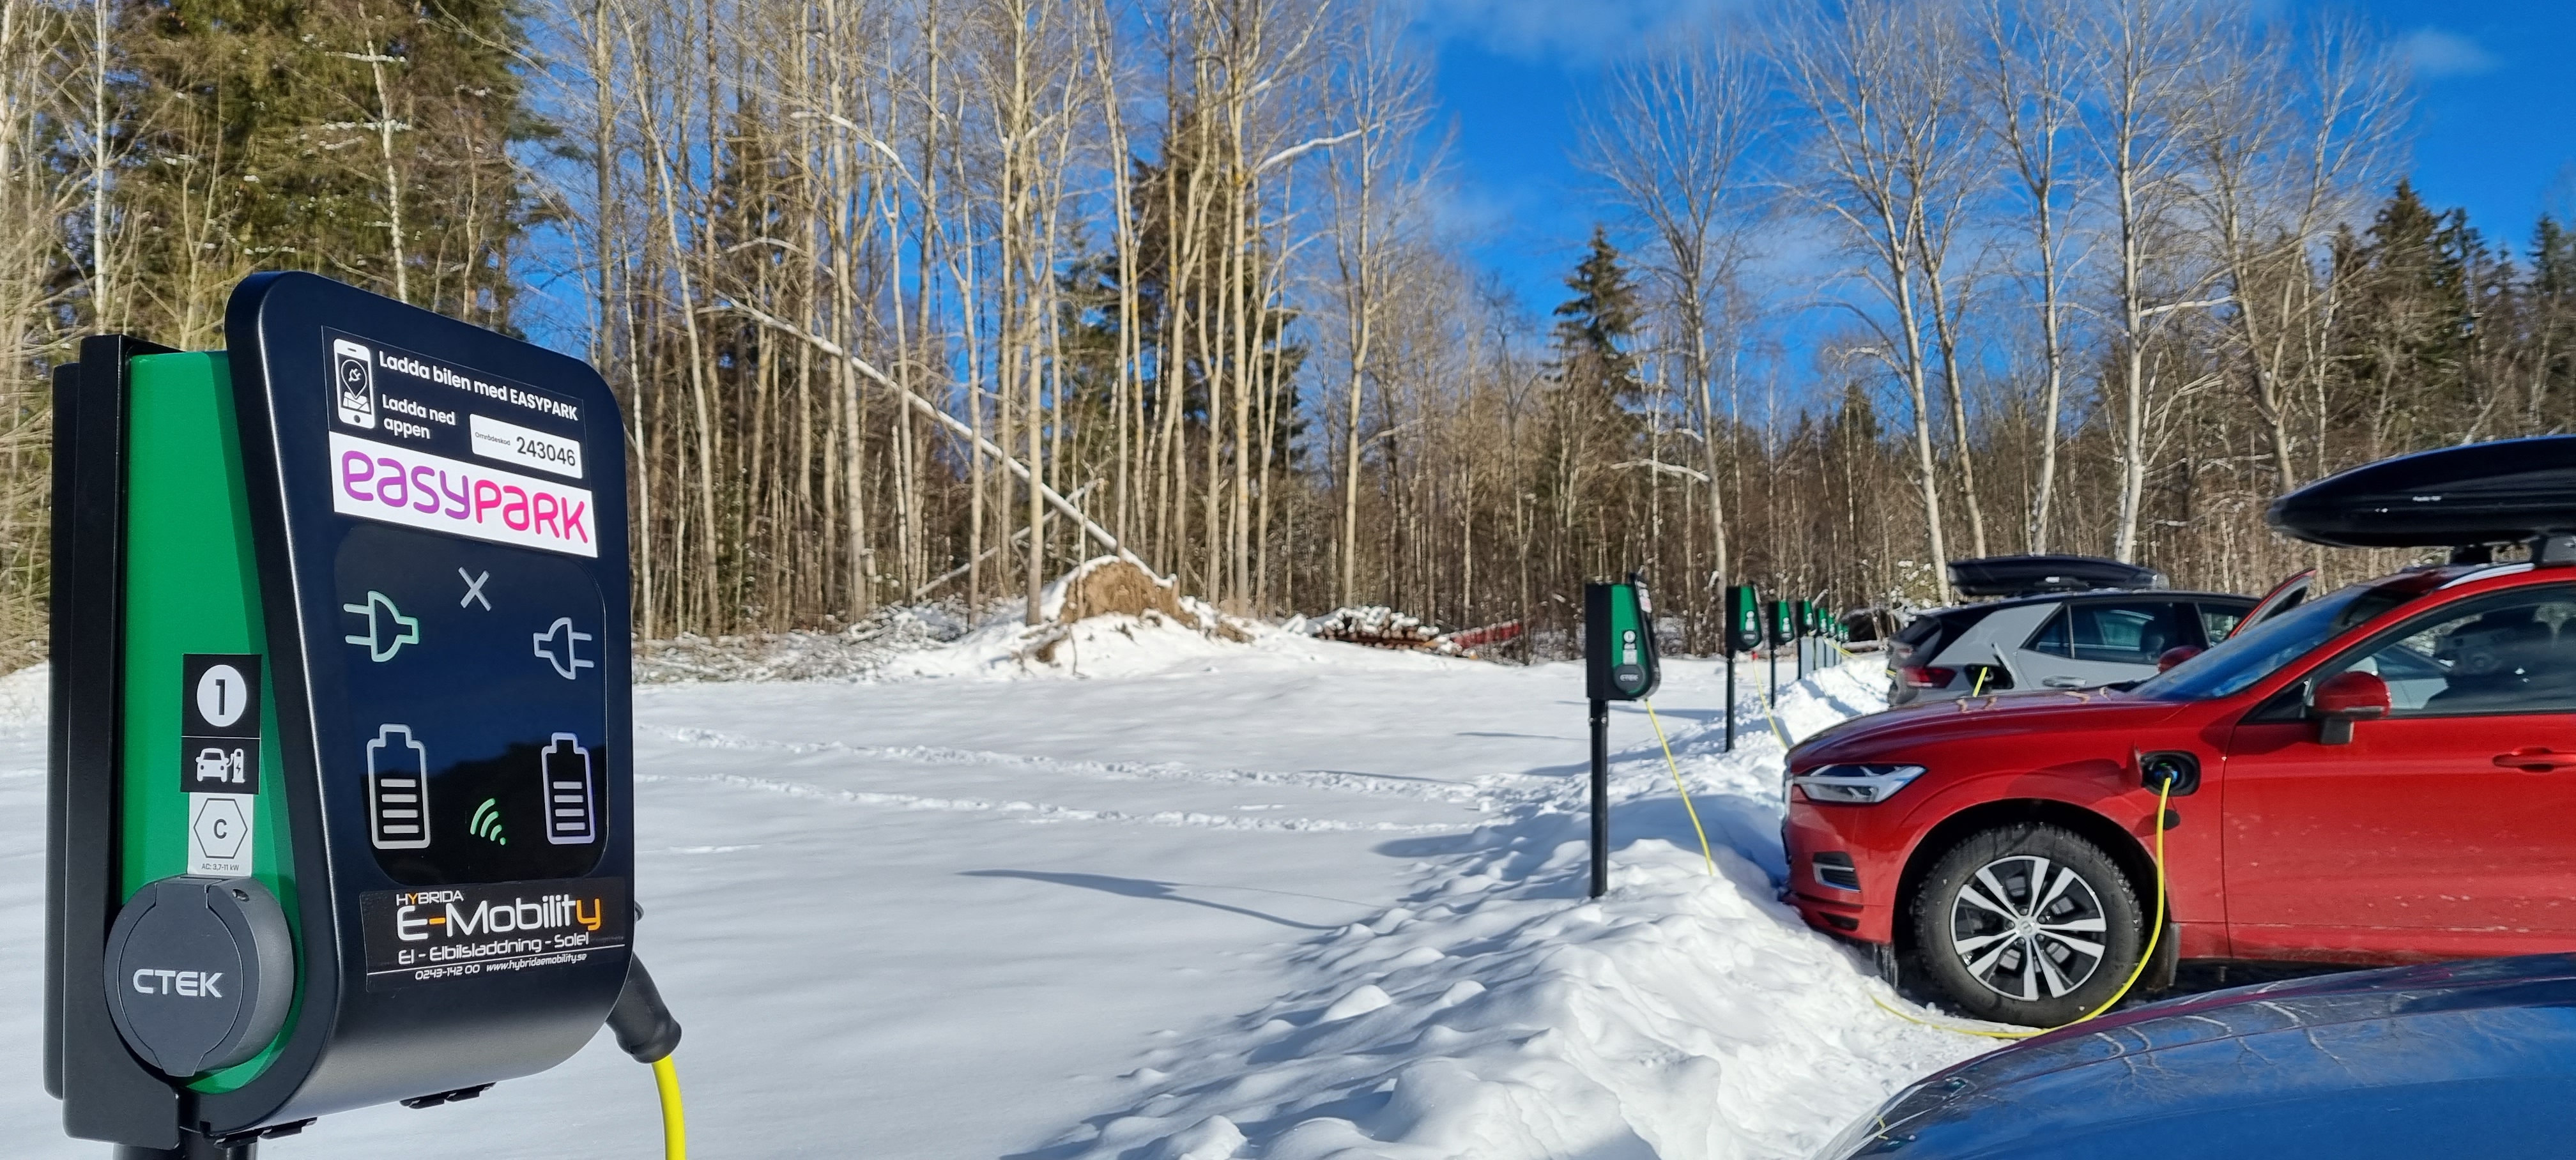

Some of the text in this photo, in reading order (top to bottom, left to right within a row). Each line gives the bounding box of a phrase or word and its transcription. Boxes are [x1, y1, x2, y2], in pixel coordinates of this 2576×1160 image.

[379, 351, 578, 421] Ladda bilen med EASYPARK
[382, 394, 456, 425] Ladda ned
[383, 418, 430, 439] appen
[475, 432, 576, 466] Områdeskod 243046
[215, 679, 226, 715] 1
[213, 818, 227, 840] C
[396, 890, 464, 906] HYBRIDA
[397, 894, 601, 941] E-Mobility
[398, 950, 415, 965] El
[429, 937, 542, 962] Elbilsladdning
[554, 932, 589, 949] Solel
[415, 952, 587, 981] 0243-142 00 www.hybridaemobility.se
[133, 968, 222, 998] CTEK
